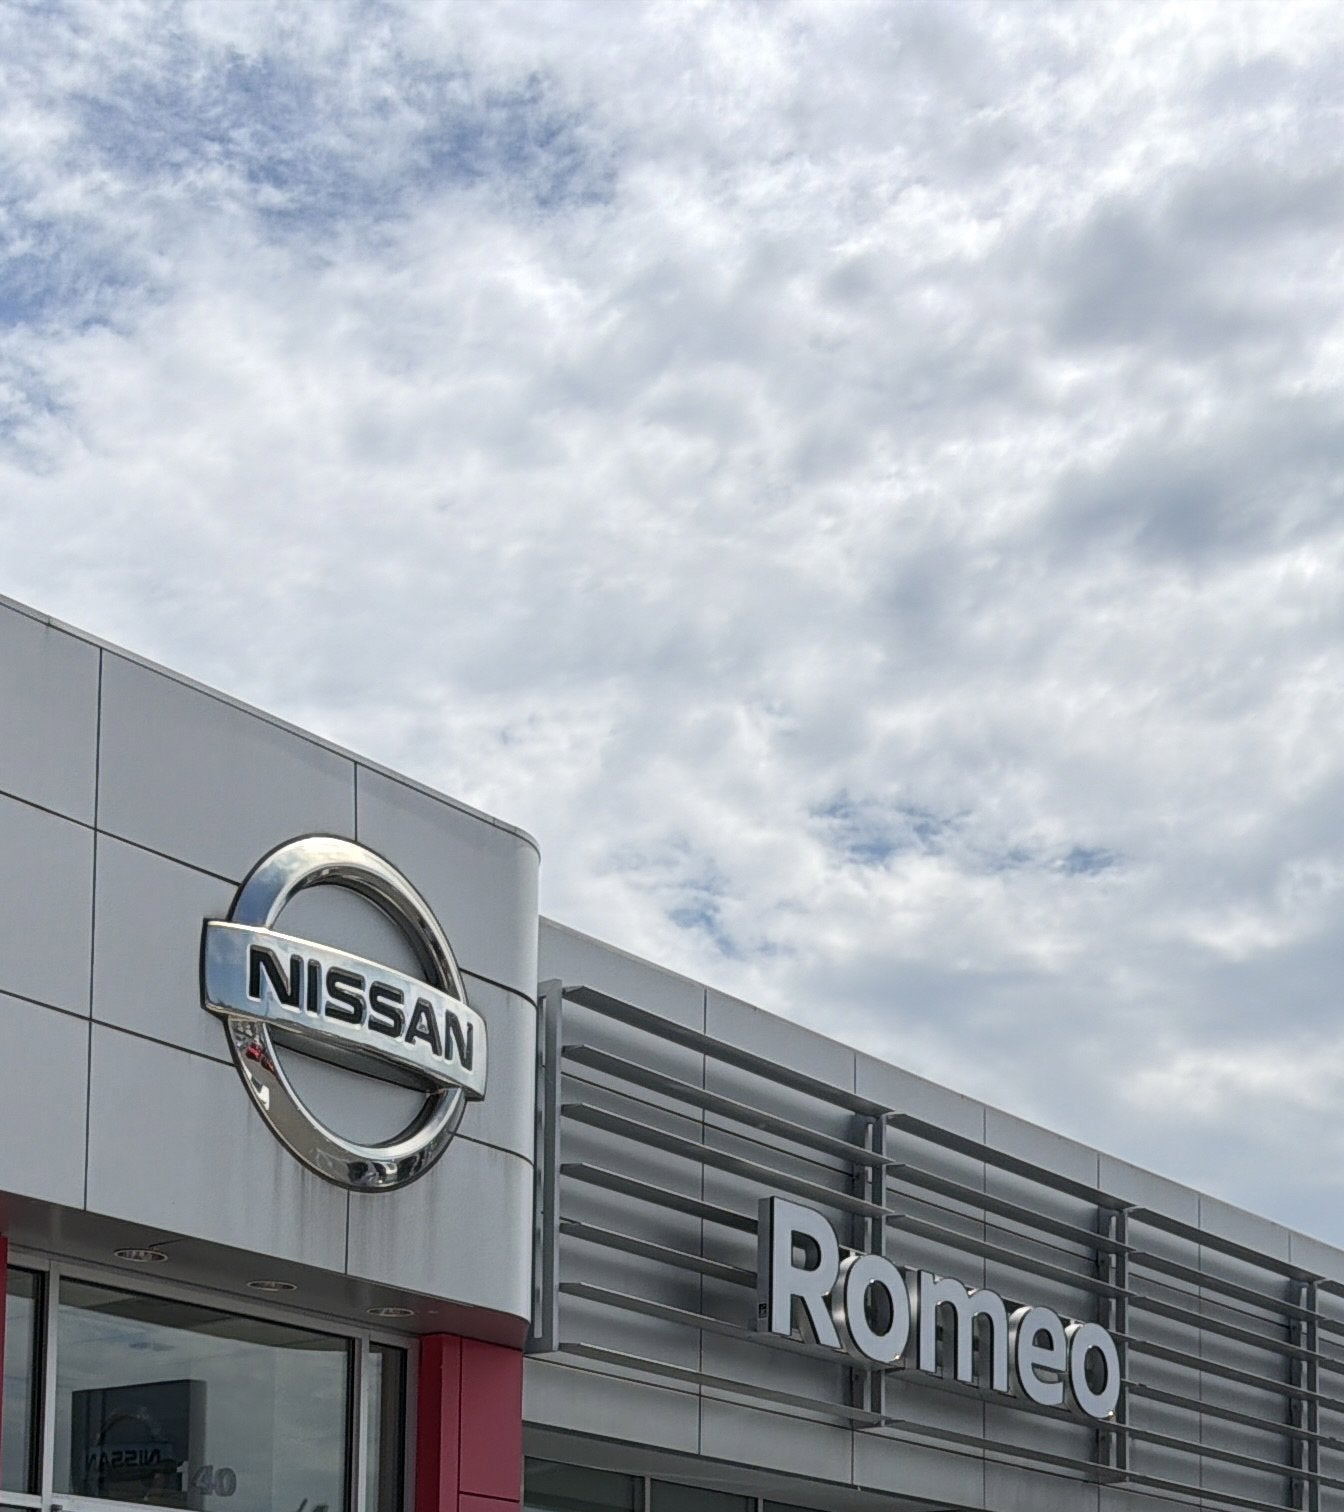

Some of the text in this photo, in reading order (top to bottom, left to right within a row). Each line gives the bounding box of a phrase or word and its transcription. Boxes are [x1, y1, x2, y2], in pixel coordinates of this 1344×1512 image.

[248, 943, 475, 1073] NISSAN
[759, 1195, 1121, 1420] Romeo
[176, 1460, 237, 1498] 140
